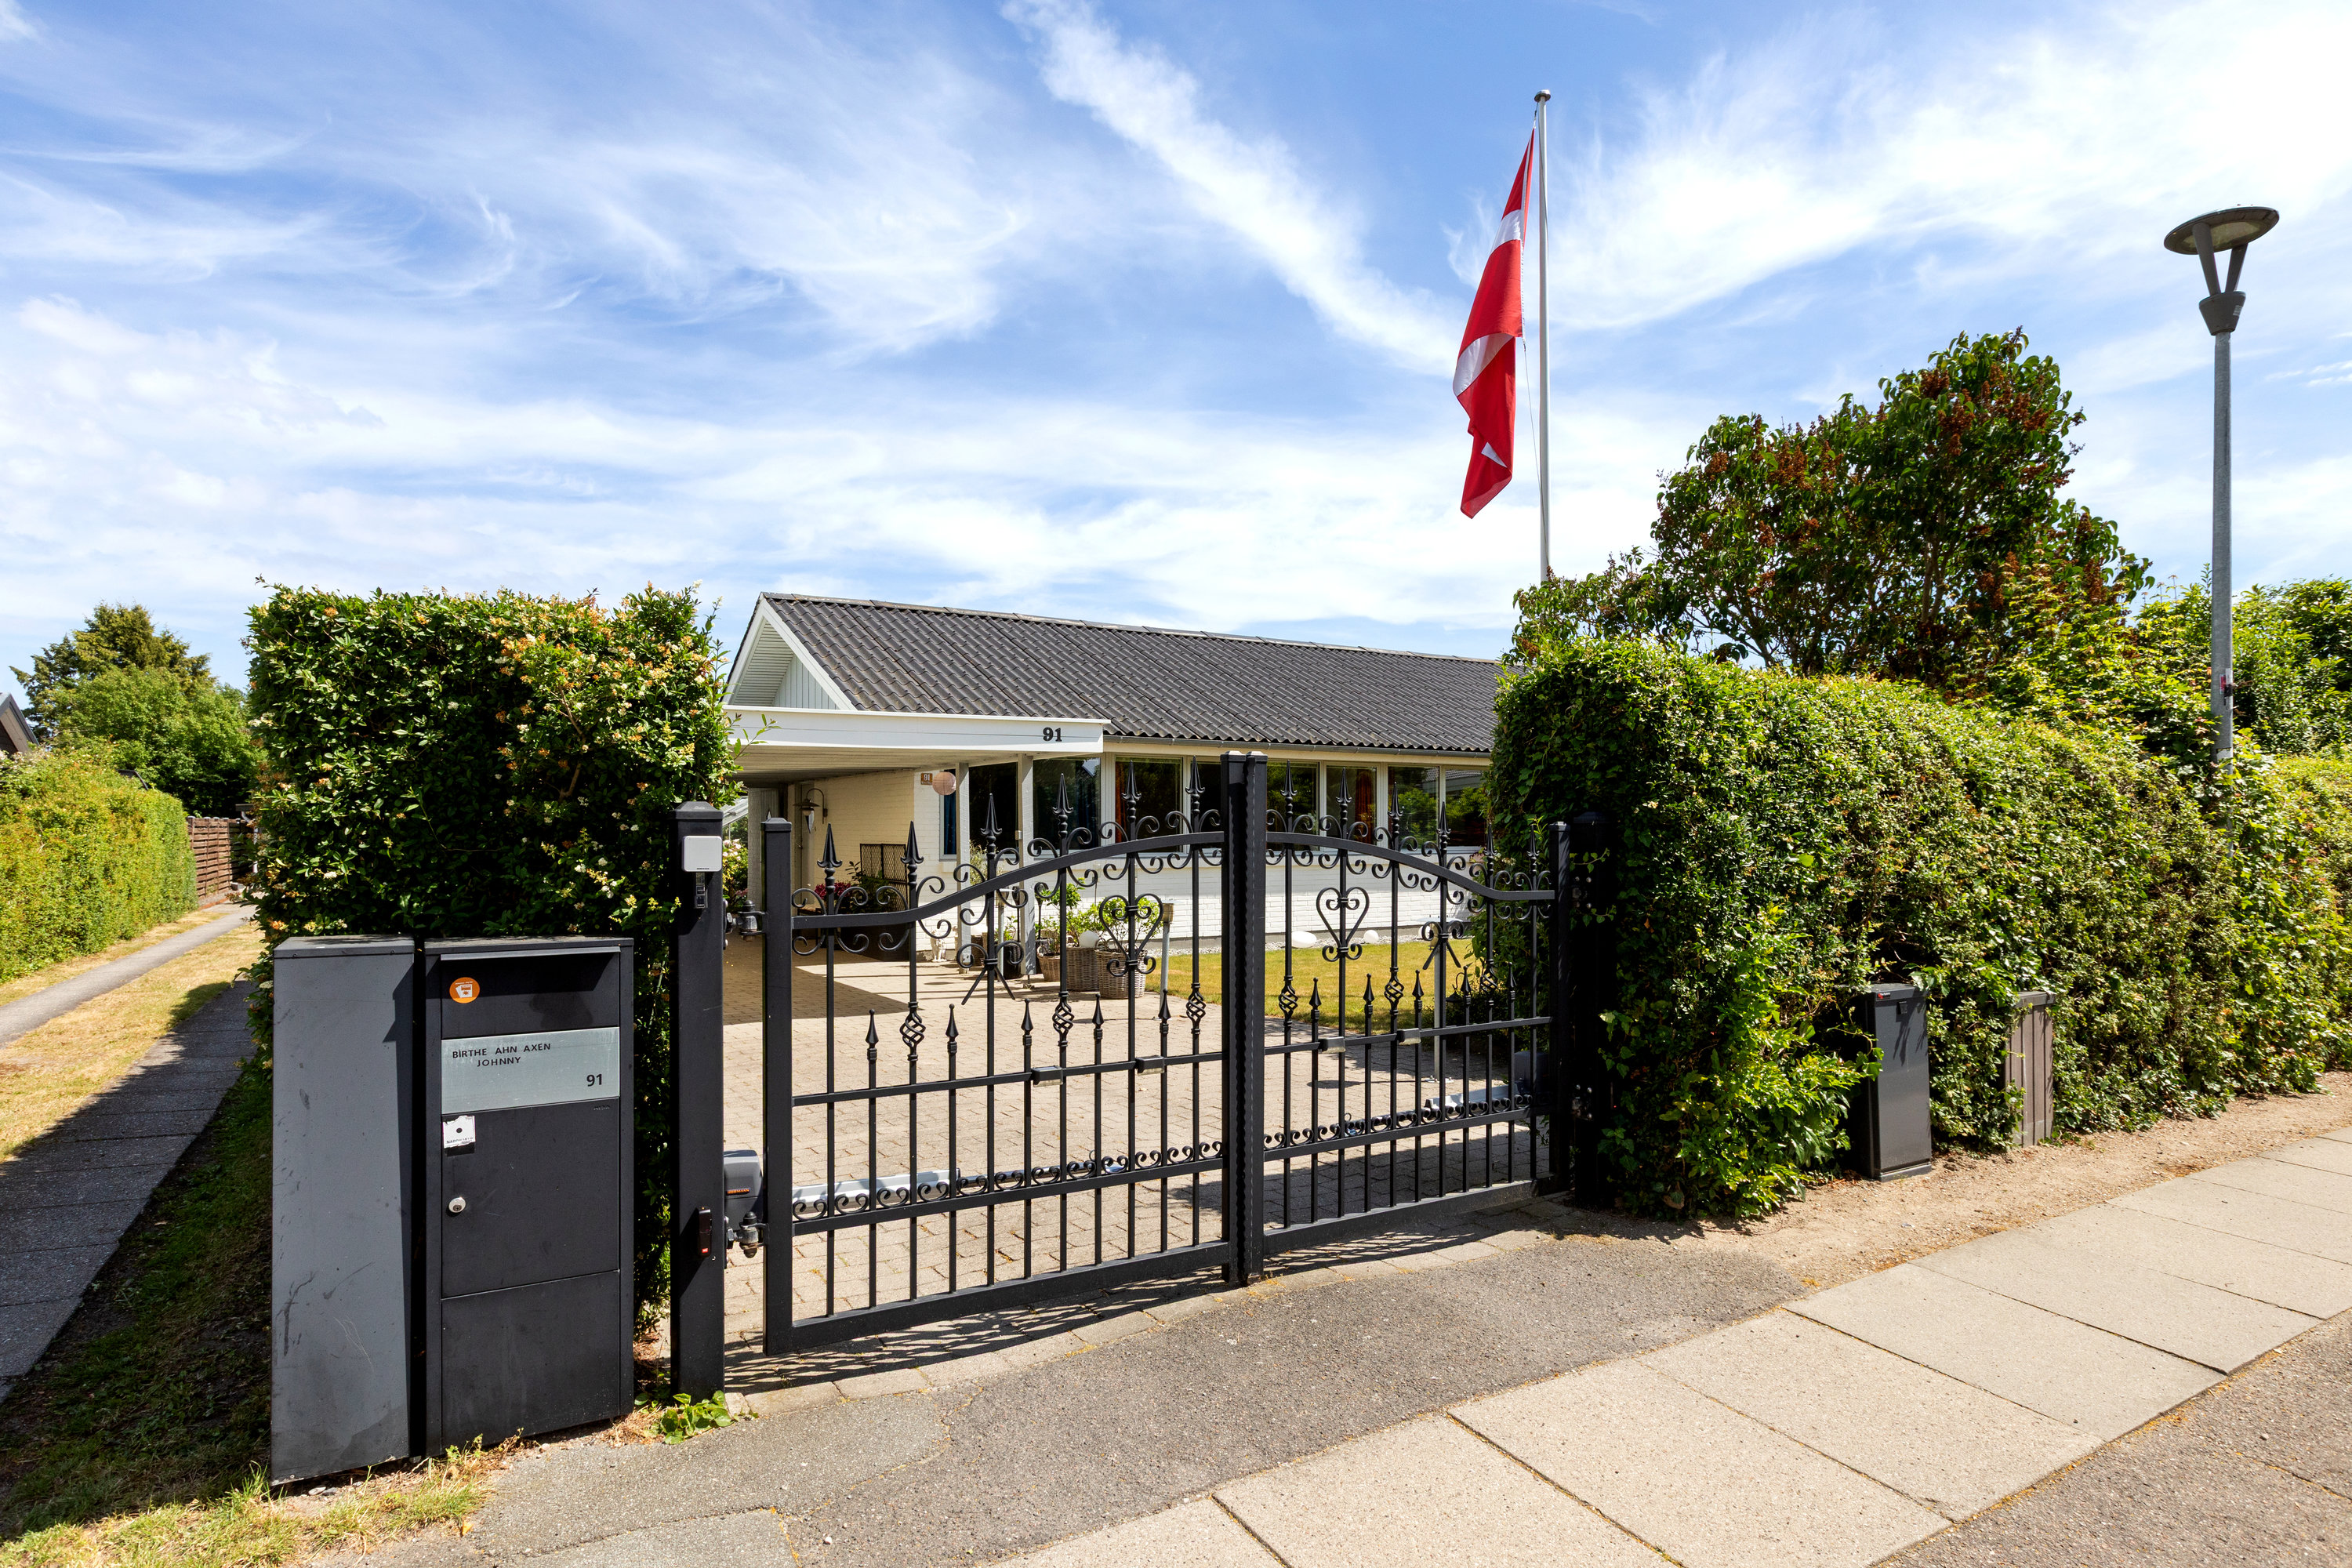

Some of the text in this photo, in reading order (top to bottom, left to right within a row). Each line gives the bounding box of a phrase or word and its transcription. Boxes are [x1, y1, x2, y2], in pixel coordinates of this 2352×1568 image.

[1043, 727, 1062, 742] 91
[495, 1046, 517, 1054] AHN
[524, 1044, 550, 1052] AXEN
[477, 1057, 521, 1067] JOHNNY
[586, 1073, 602, 1087] 91
